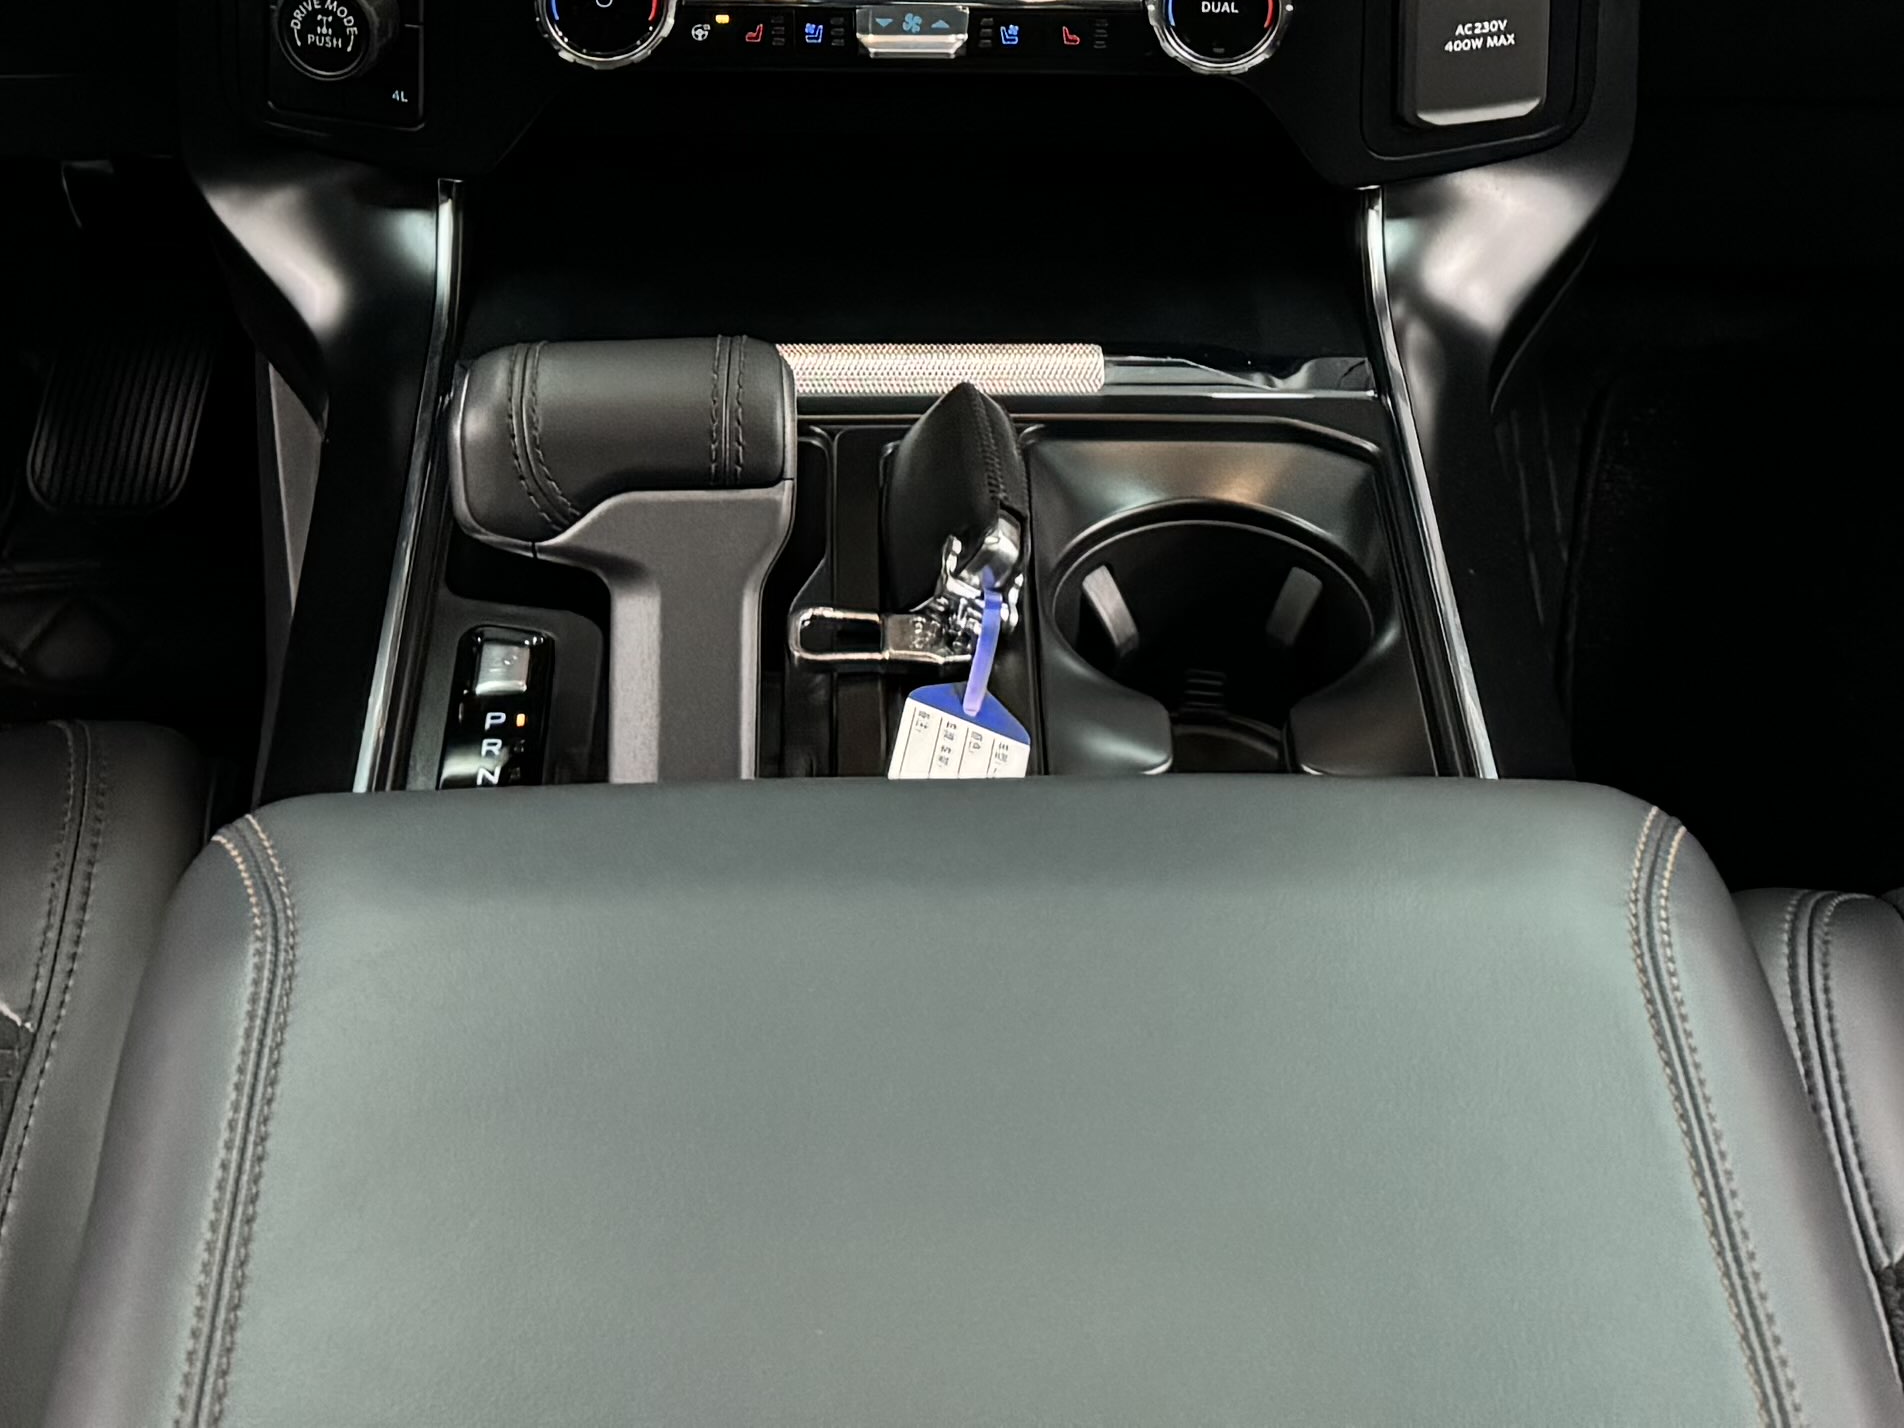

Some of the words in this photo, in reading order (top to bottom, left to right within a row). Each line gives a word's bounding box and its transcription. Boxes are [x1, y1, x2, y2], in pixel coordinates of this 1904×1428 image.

[1201, 1, 1239, 14] DUAL
[307, 33, 343, 49] PUSH
[1444, 36, 1484, 52] 400W
[1486, 33, 1516, 49] MAX
[391, 89, 409, 103] 4L
[484, 711, 507, 731] P
[481, 738, 503, 757] R
[476, 765, 502, 786] N
